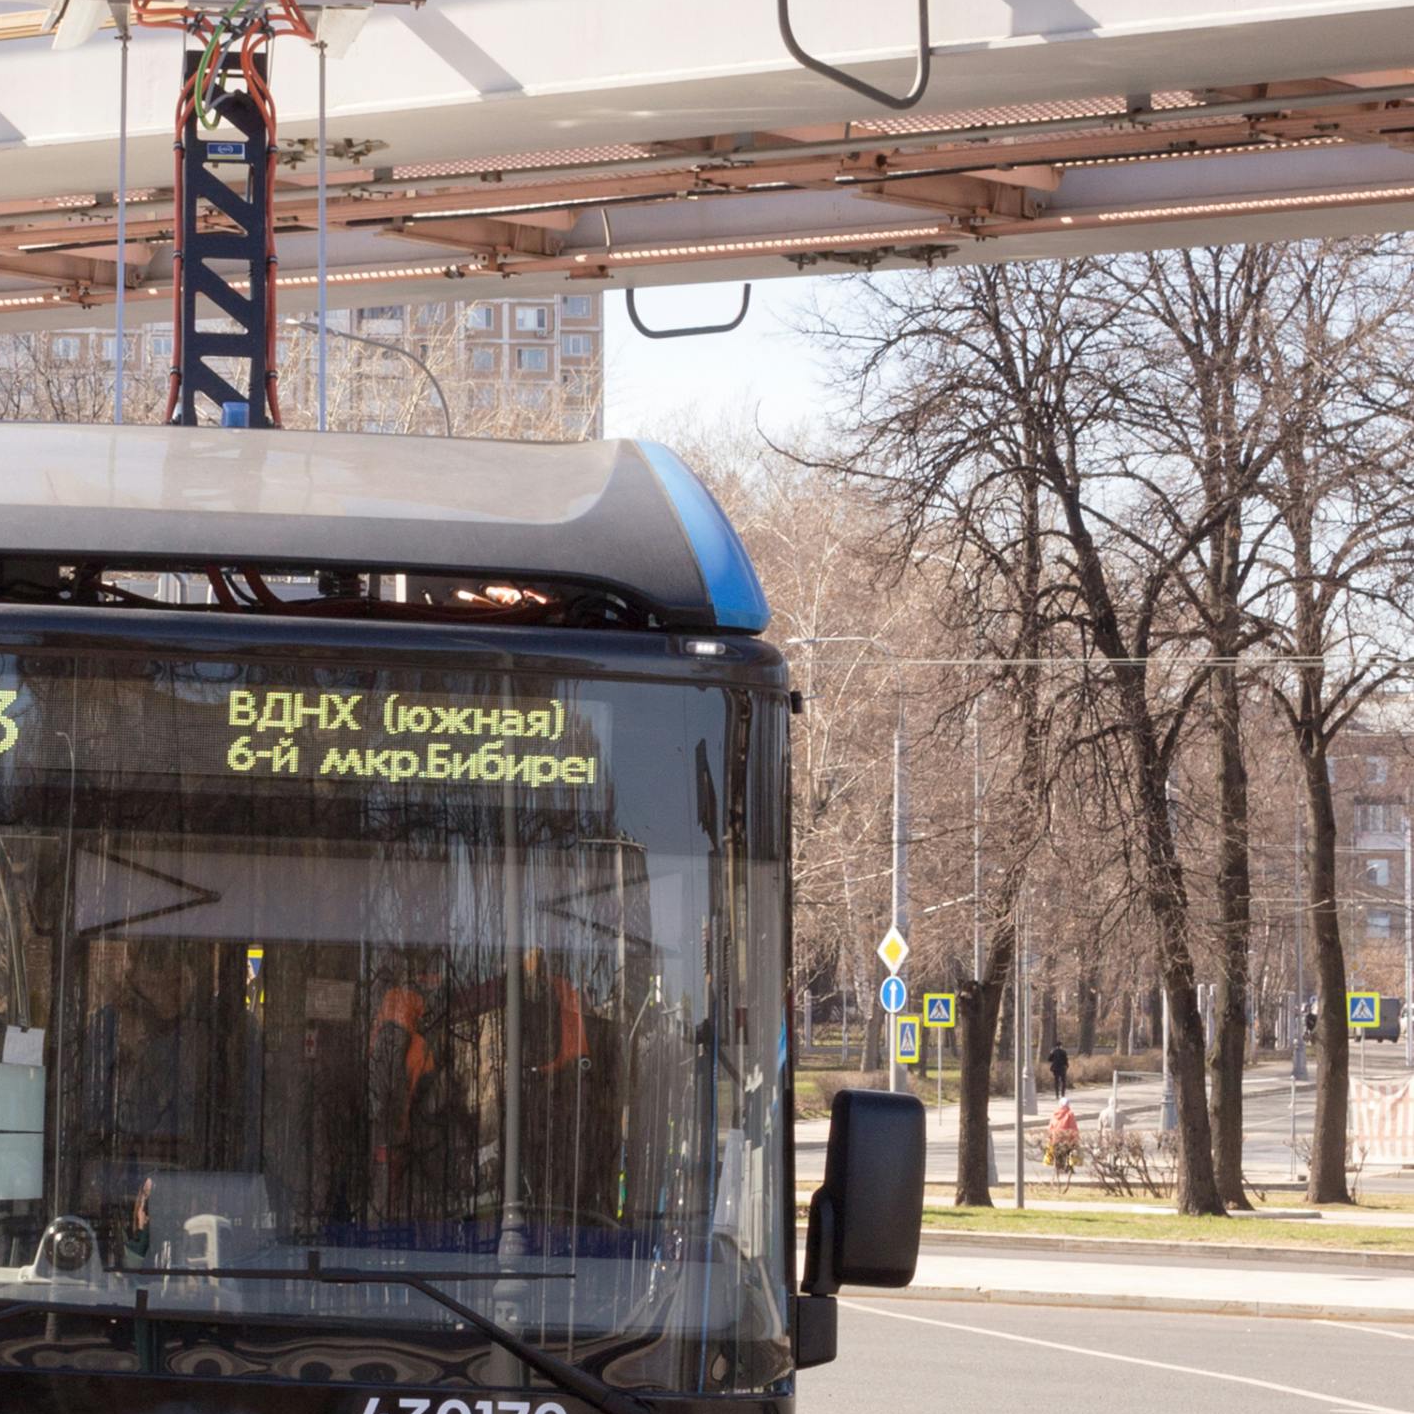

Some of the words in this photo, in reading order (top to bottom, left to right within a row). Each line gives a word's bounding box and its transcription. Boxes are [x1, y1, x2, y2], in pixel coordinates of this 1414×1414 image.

[228, 690, 362, 733] ВДНХ
[383, 693, 565, 741] (южная)
[227, 735, 299, 774] 6-й
